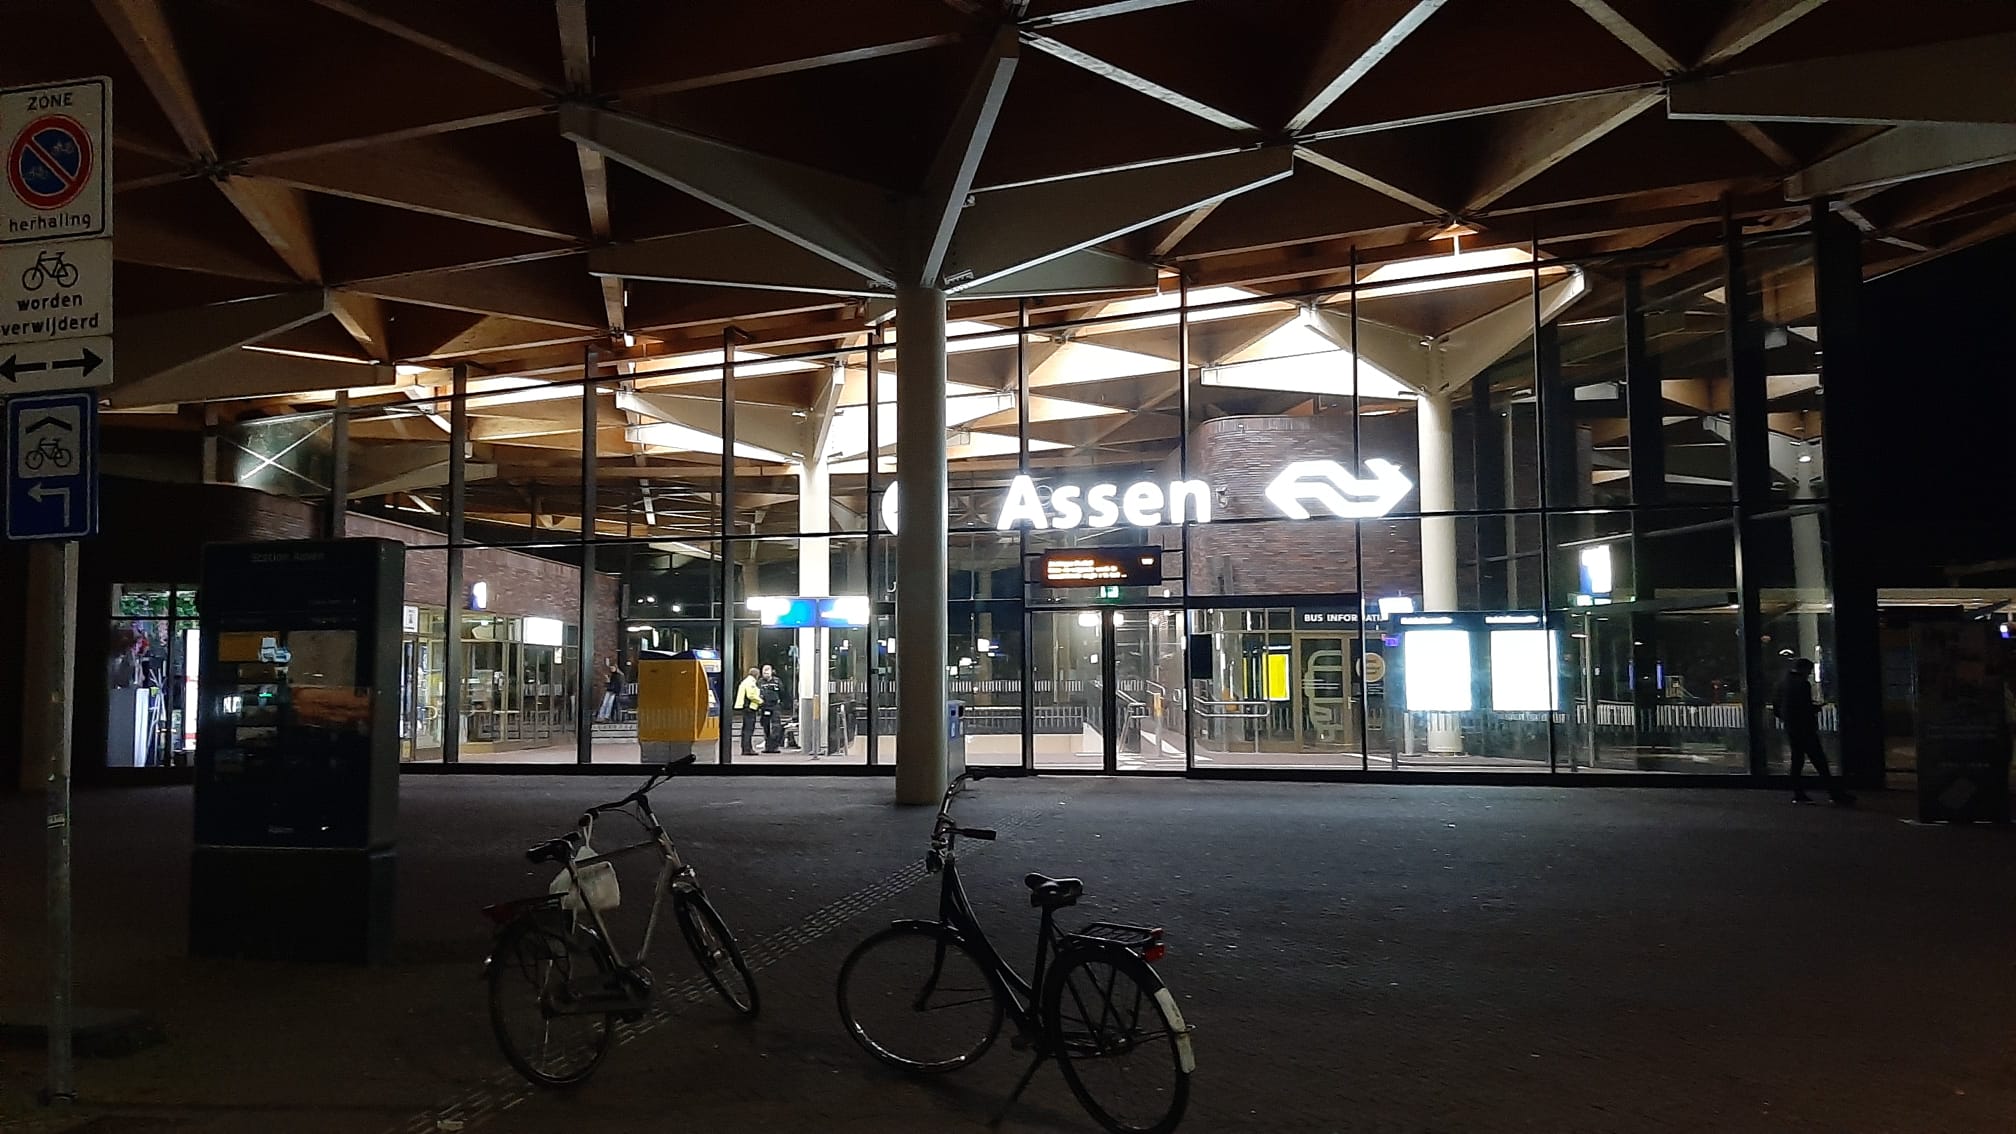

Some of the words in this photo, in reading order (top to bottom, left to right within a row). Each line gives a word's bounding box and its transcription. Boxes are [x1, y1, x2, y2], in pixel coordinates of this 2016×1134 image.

[27, 93, 73, 111] ZONE
[9, 213, 91, 233] herhaling
[17, 292, 83, 312] worden
[1, 312, 99, 338] verwijderd
[997, 474, 1213, 531] Assen
[1304, 613, 1324, 622] BUS
[1327, 613, 1384, 622] INFORATI
